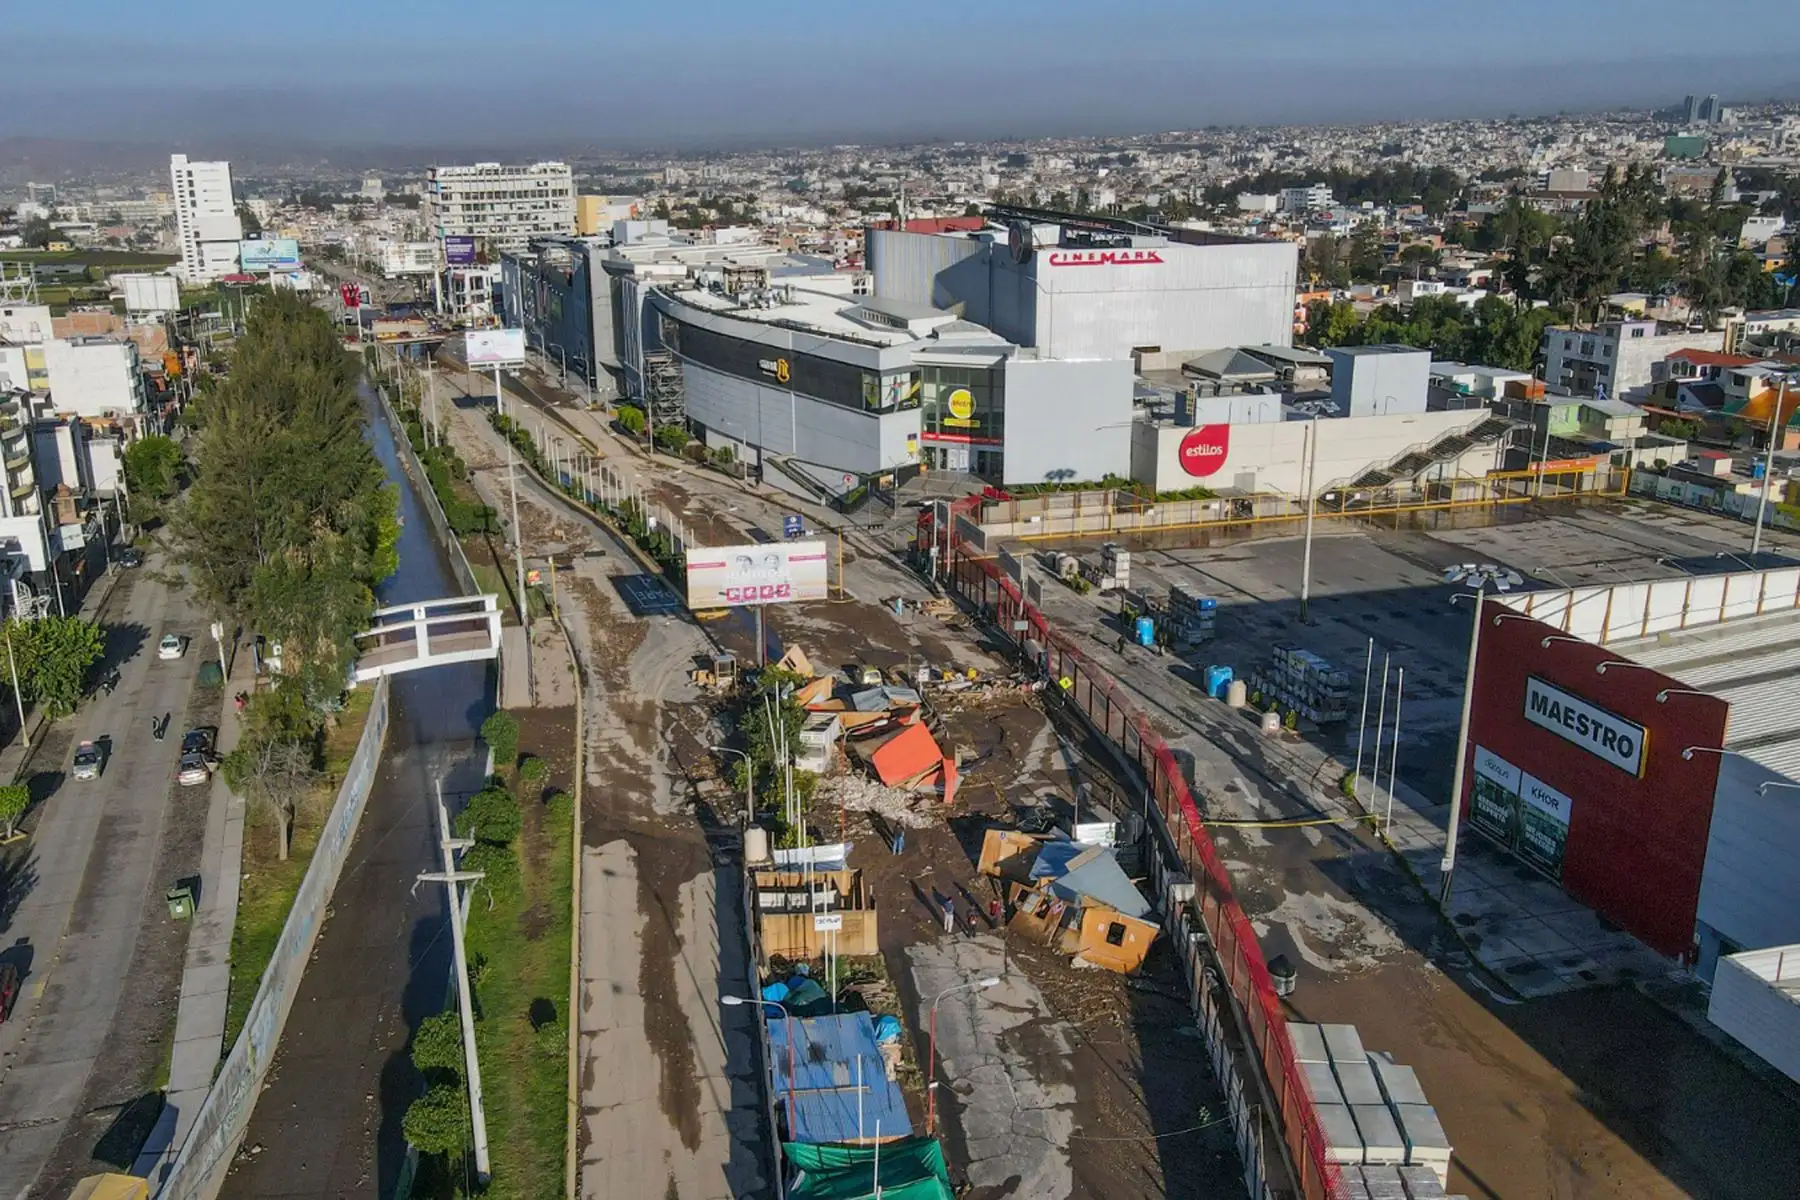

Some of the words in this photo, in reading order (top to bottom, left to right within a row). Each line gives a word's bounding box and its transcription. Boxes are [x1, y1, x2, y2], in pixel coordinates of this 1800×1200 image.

[1049, 251, 1164, 266] CINEMARK
[1186, 444, 1223, 457] estilos
[1530, 690, 1634, 759] MAESTRO
[1530, 786, 1560, 811] KHOR
